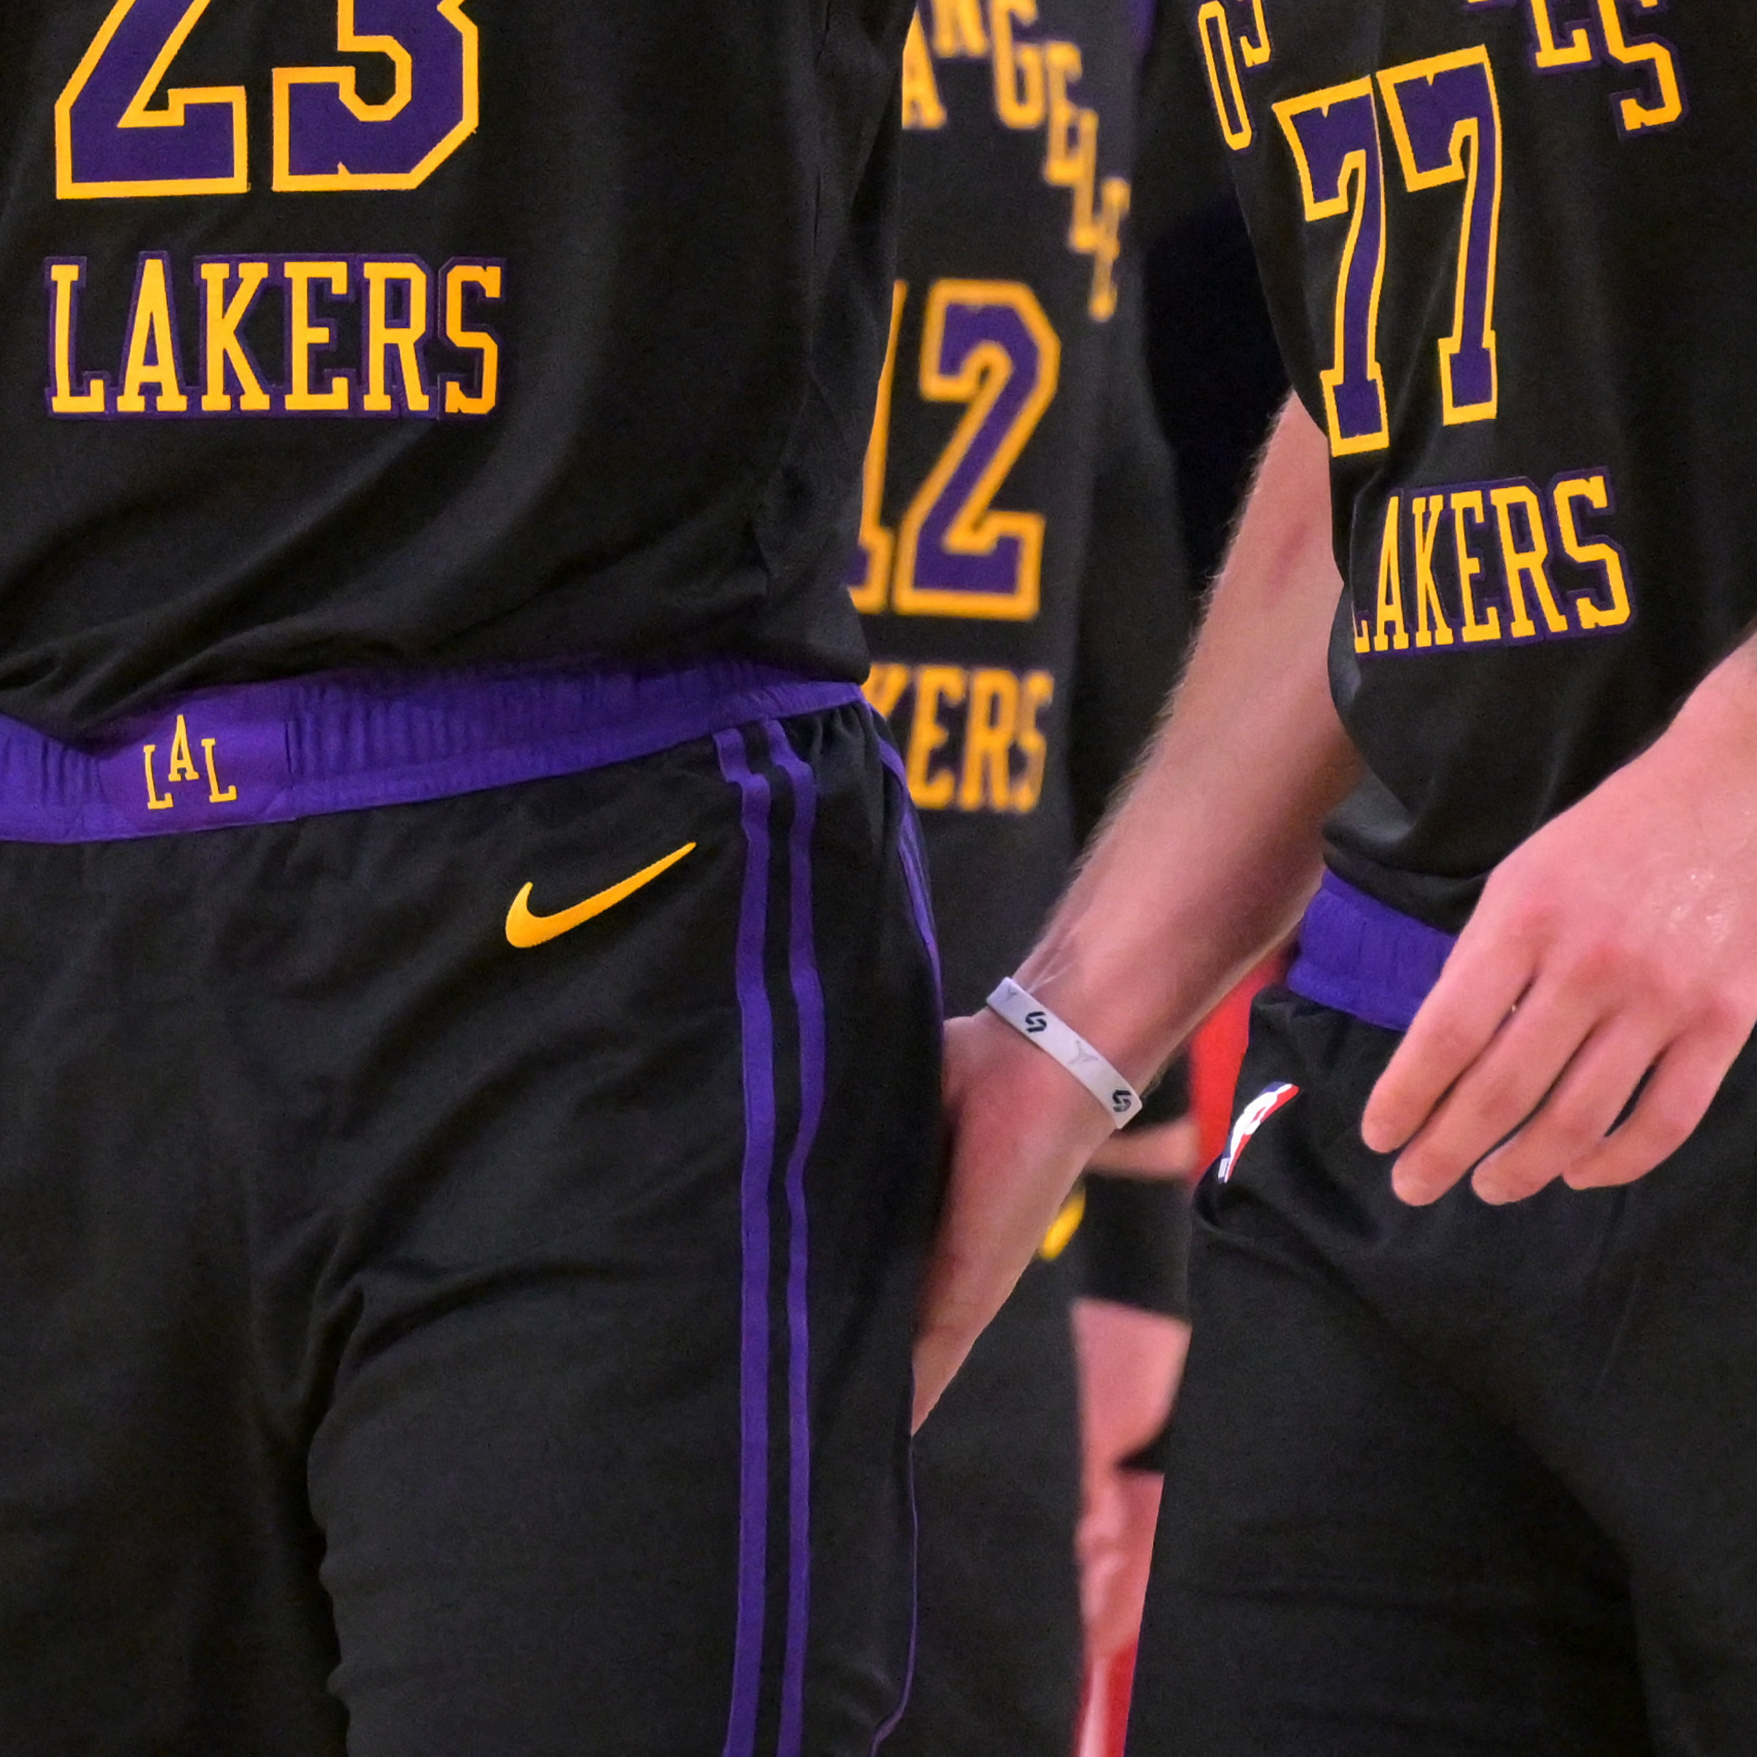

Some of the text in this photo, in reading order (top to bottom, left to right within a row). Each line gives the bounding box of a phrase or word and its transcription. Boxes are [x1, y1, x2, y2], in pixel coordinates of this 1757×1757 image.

[1274, 46, 1503, 456] 77
[51, 257, 502, 415] LAKERS
[143, 714, 238, 810] LAL
